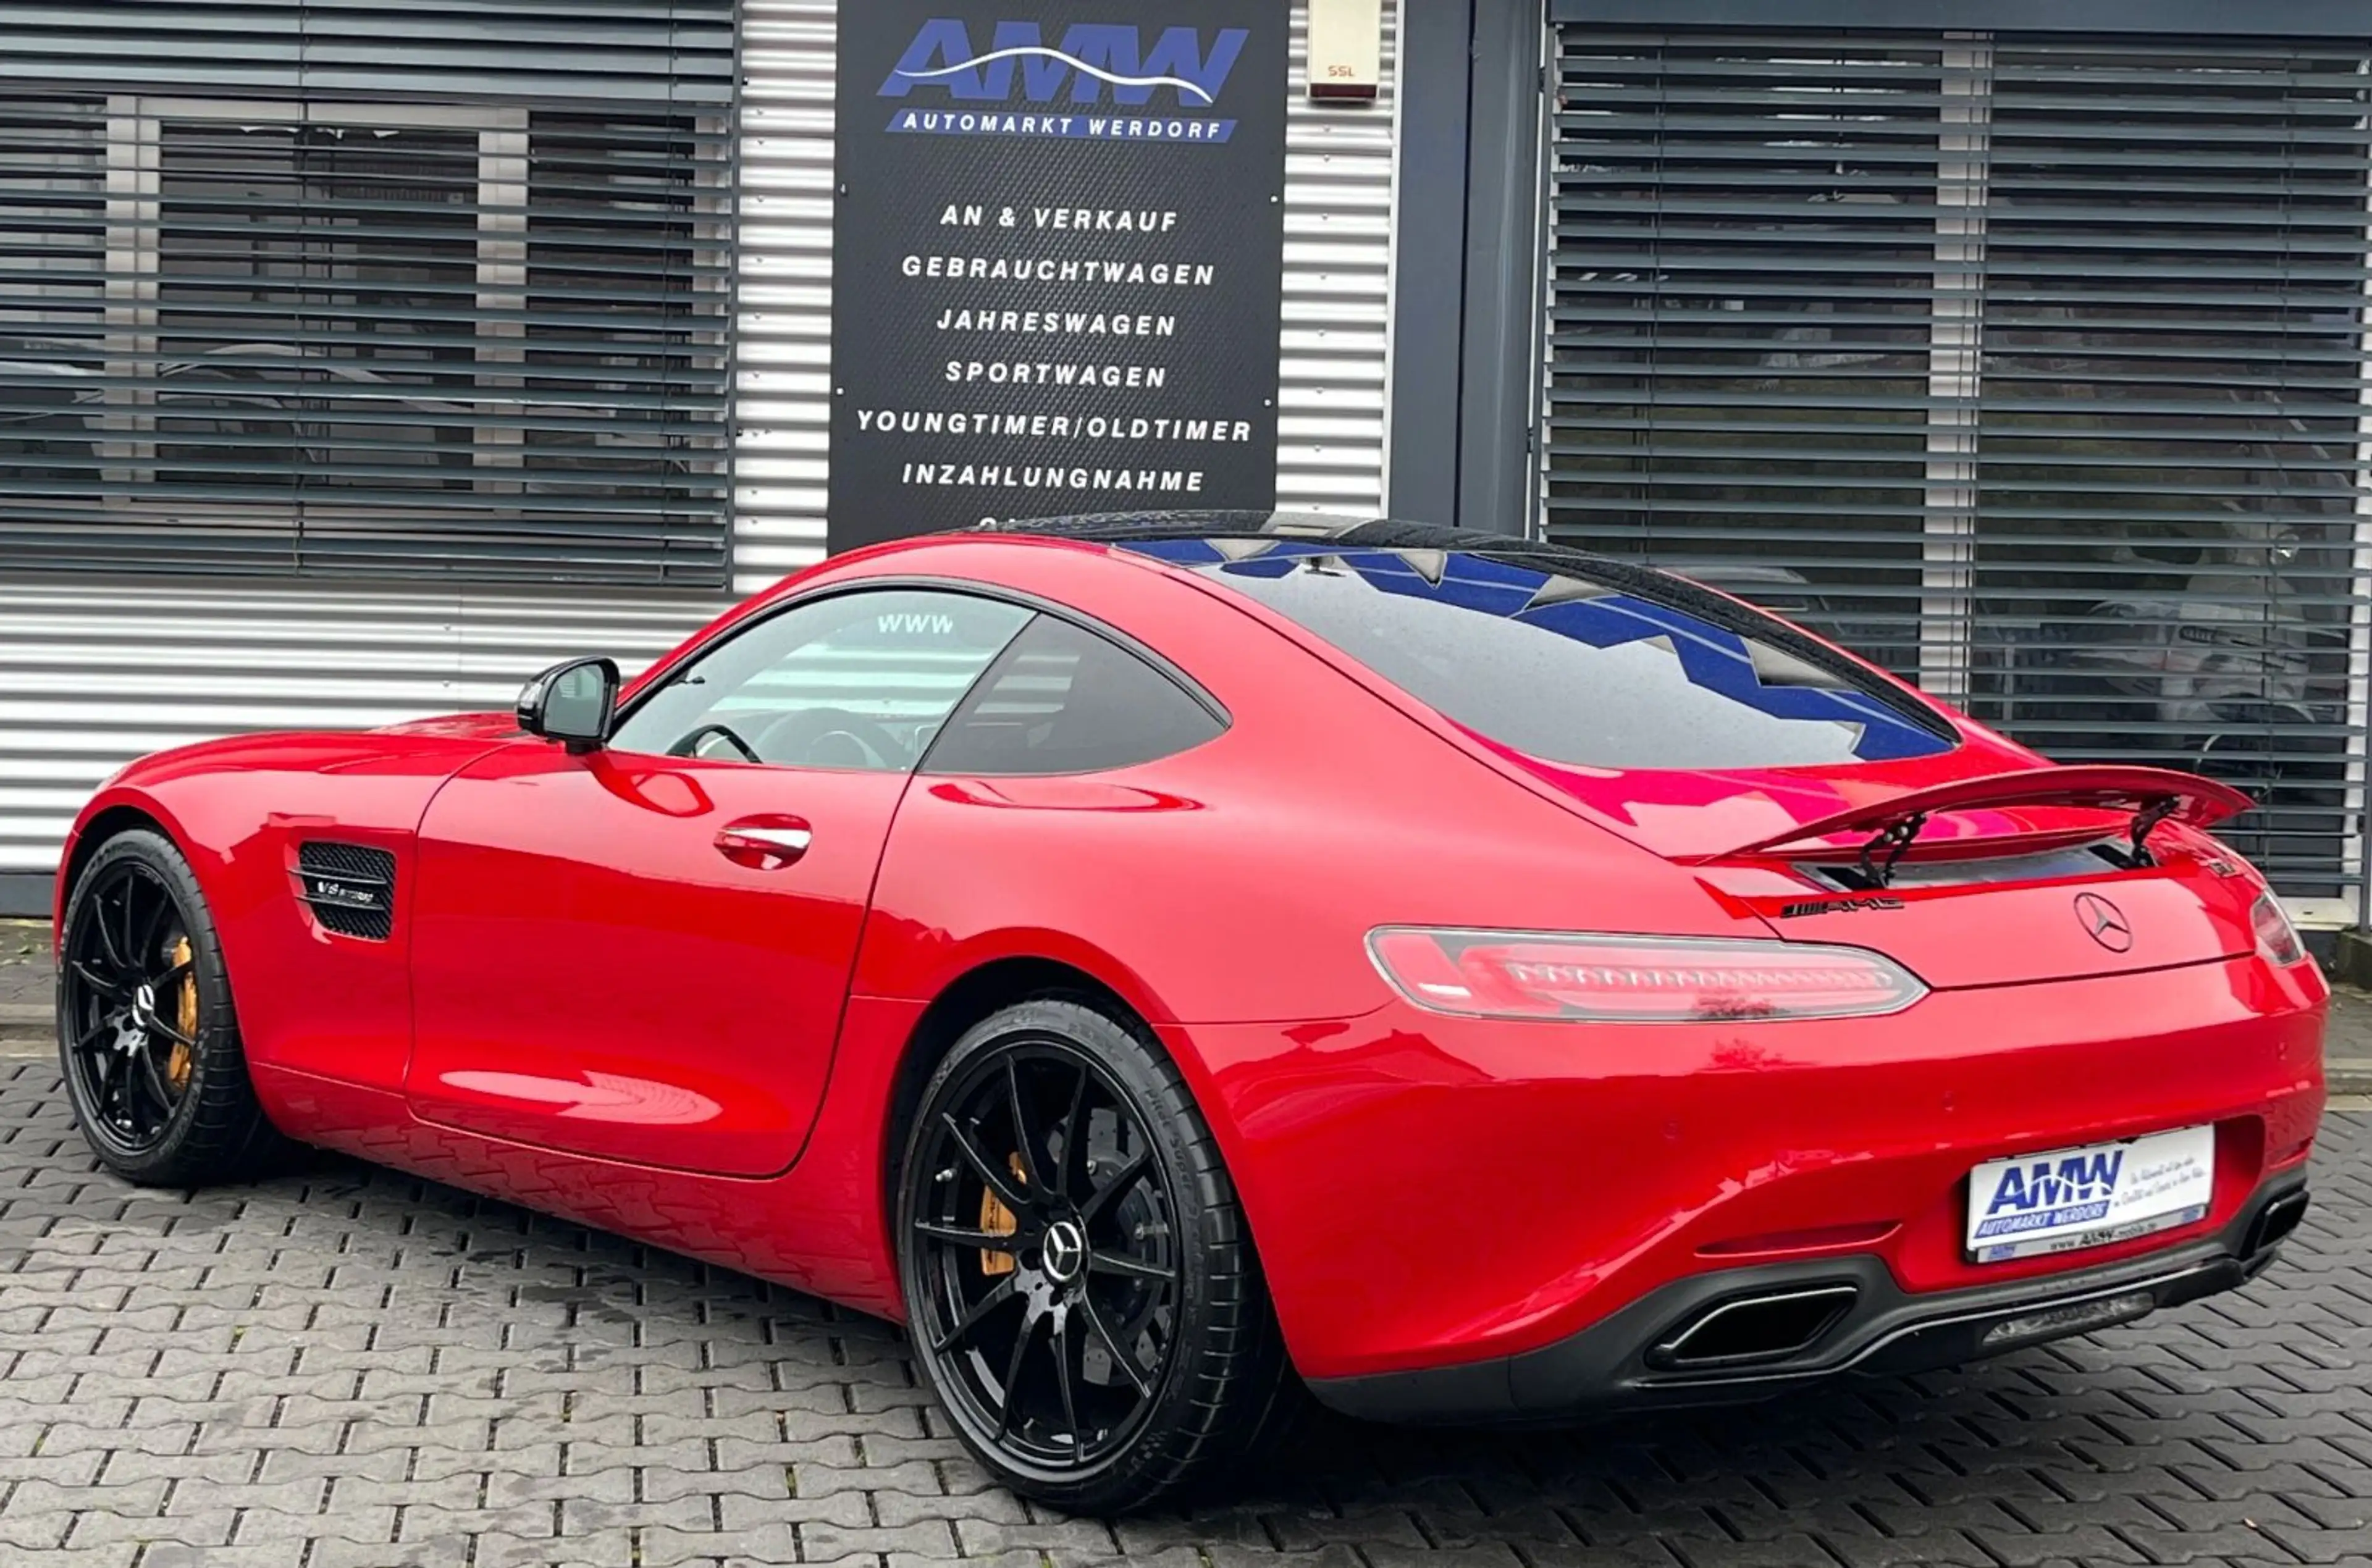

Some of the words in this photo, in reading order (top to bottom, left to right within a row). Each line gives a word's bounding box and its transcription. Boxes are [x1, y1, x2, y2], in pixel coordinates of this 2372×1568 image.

[876, 19, 1250, 107] AMW
[902, 112, 1073, 135] AUTOMARKT
[1088, 118, 1221, 139] WERDORF
[940, 204, 983, 227] AN
[998, 206, 1016, 228] &
[1033, 208, 1177, 232] VERKAUF
[901, 255, 1214, 285] GEBRAUCHTWAGEN
[936, 309, 1175, 337] JAHRESWAGEN
[945, 361, 1166, 388] SPORTWAGEN
[857, 410, 1251, 442] YOUNGTIMER/OLDTIMER
[902, 463, 1204, 492] INZAHLUNGNAHME
[1985, 1149, 2124, 1215] AMW
